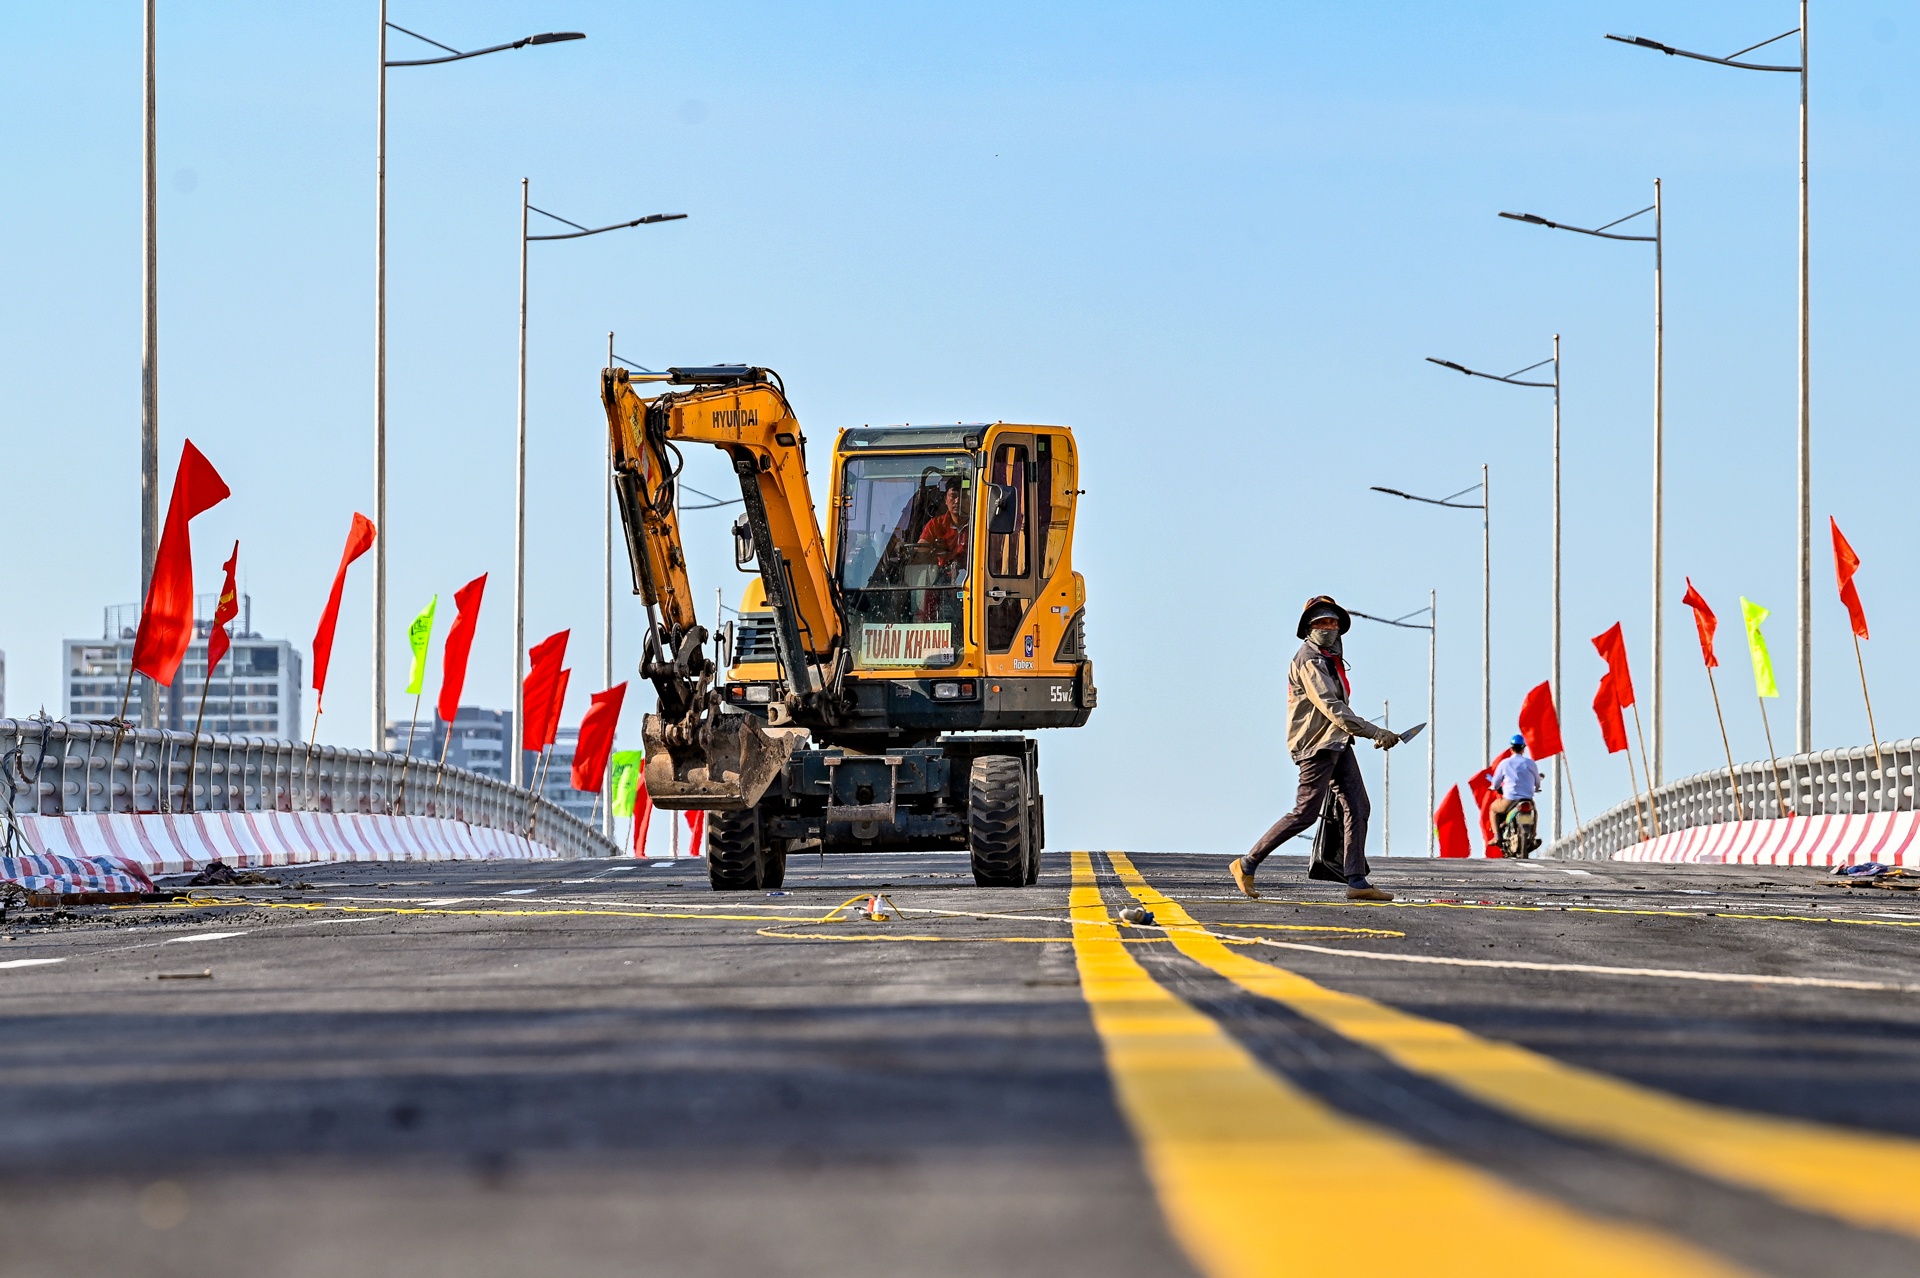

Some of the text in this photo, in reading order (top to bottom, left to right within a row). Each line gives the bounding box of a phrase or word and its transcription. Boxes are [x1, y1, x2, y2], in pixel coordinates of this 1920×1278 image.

[712, 409, 758, 428] HYUNDAI
[865, 623, 902, 660] TUẤN
[1013, 658, 1034, 670] Robex
